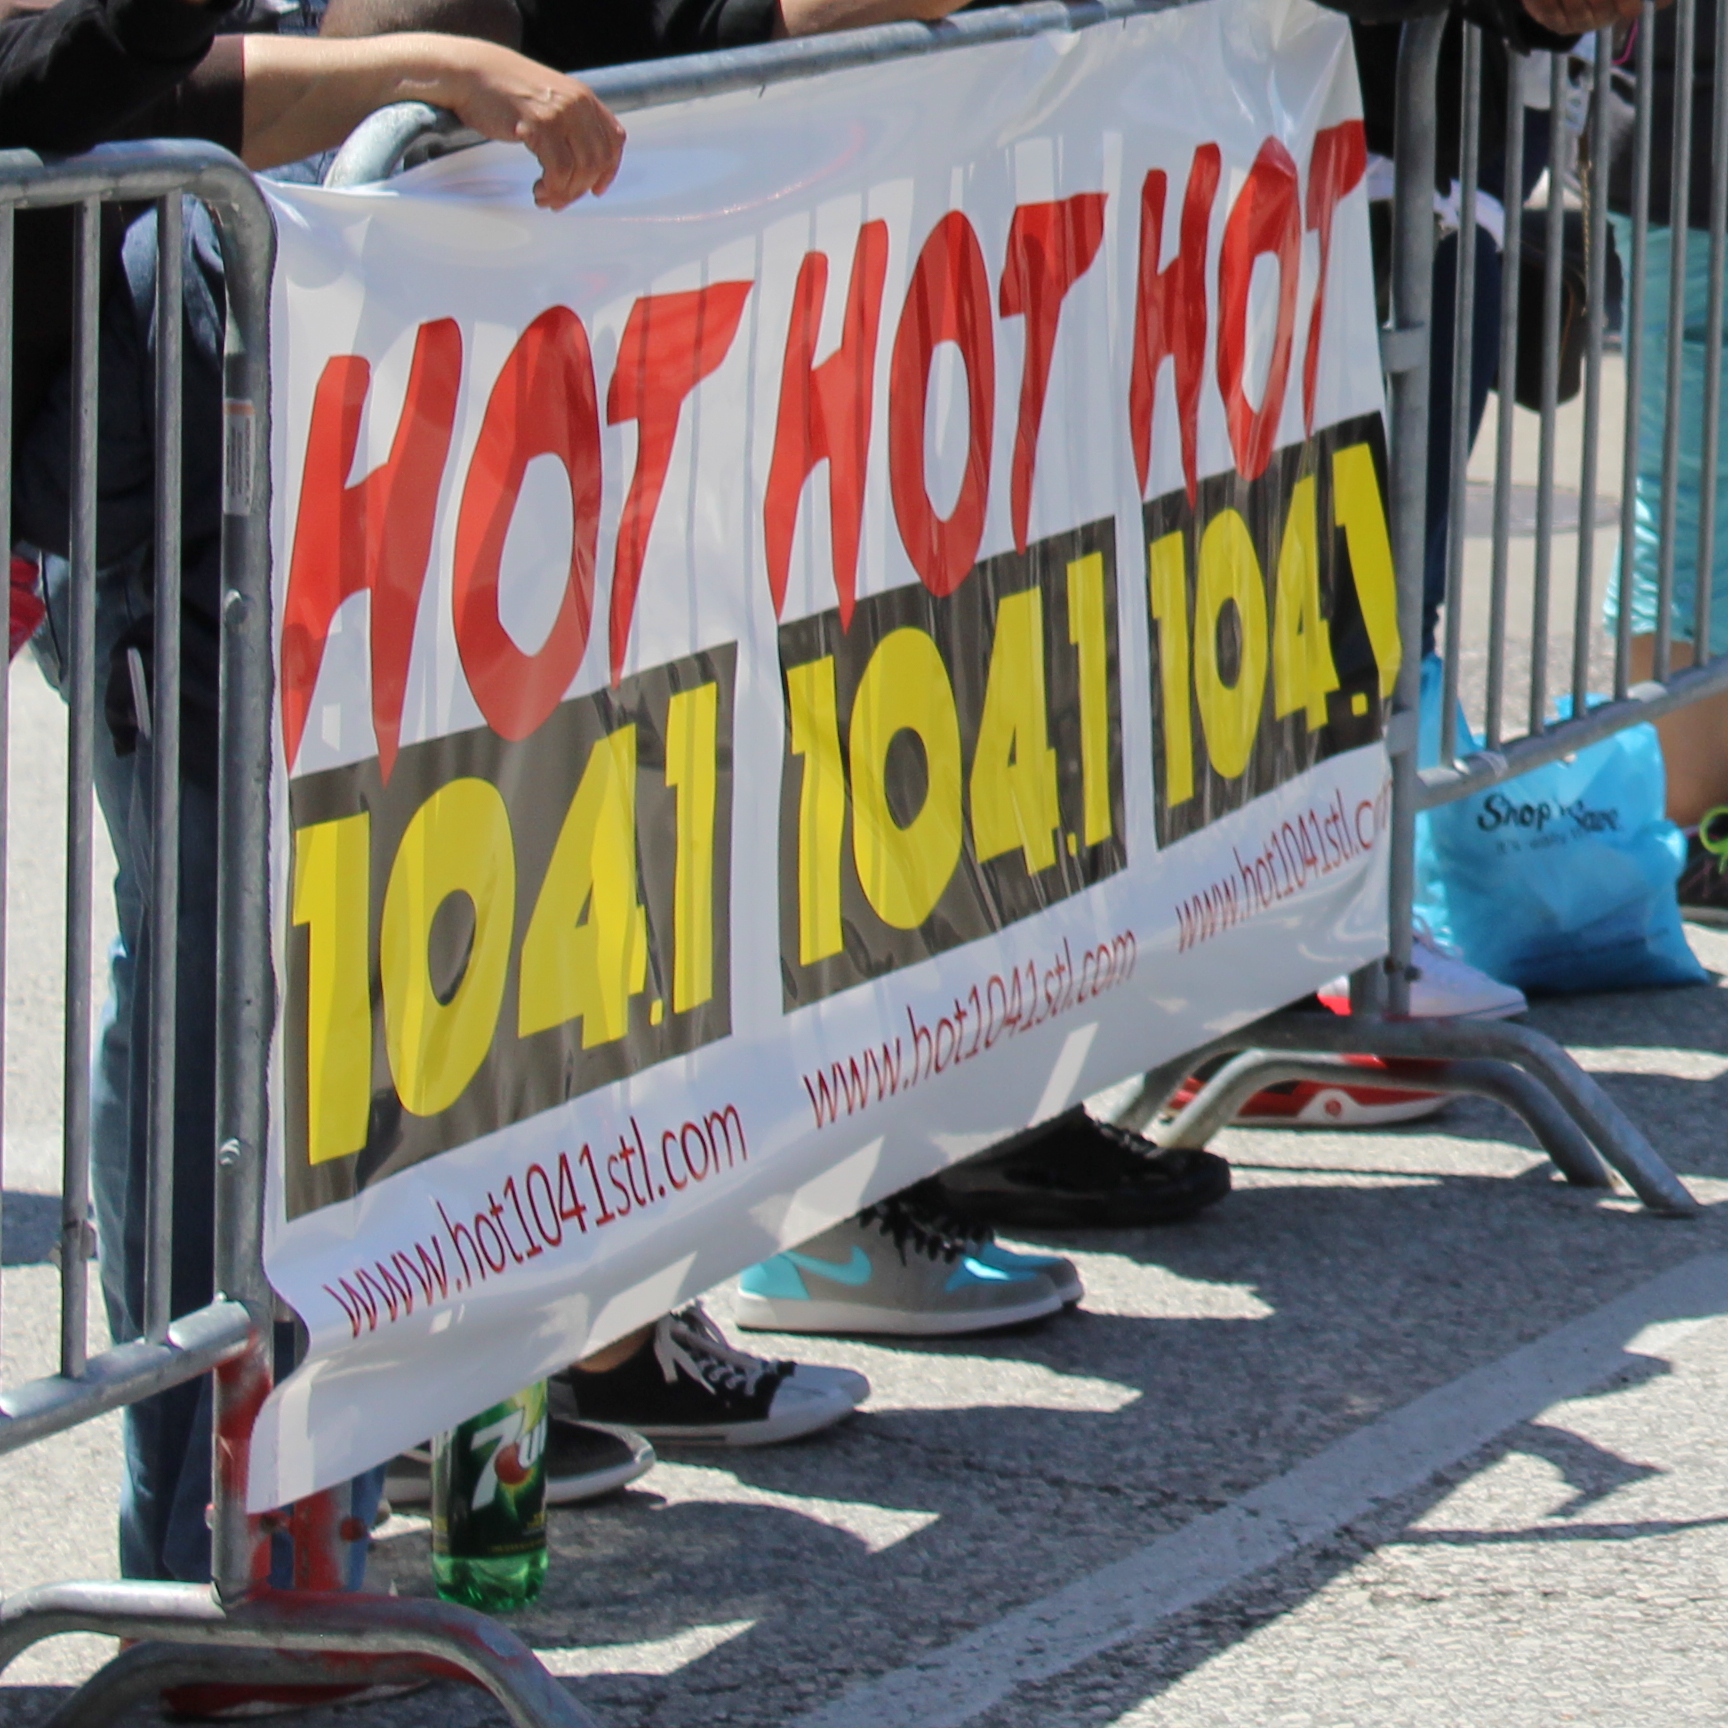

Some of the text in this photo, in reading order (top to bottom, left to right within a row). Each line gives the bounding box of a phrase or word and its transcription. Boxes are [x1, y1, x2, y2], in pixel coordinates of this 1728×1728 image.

[281, 120, 1368, 788] HOT HOT HOT
[290, 681, 720, 1167] 104.1
[785, 551, 1113, 967] 104.1
[1477, 792, 1550, 831] Shop
[322, 1103, 748, 1339] www.hot1041stl.com
[802, 928, 1137, 1130] www.hot1041stl.com
